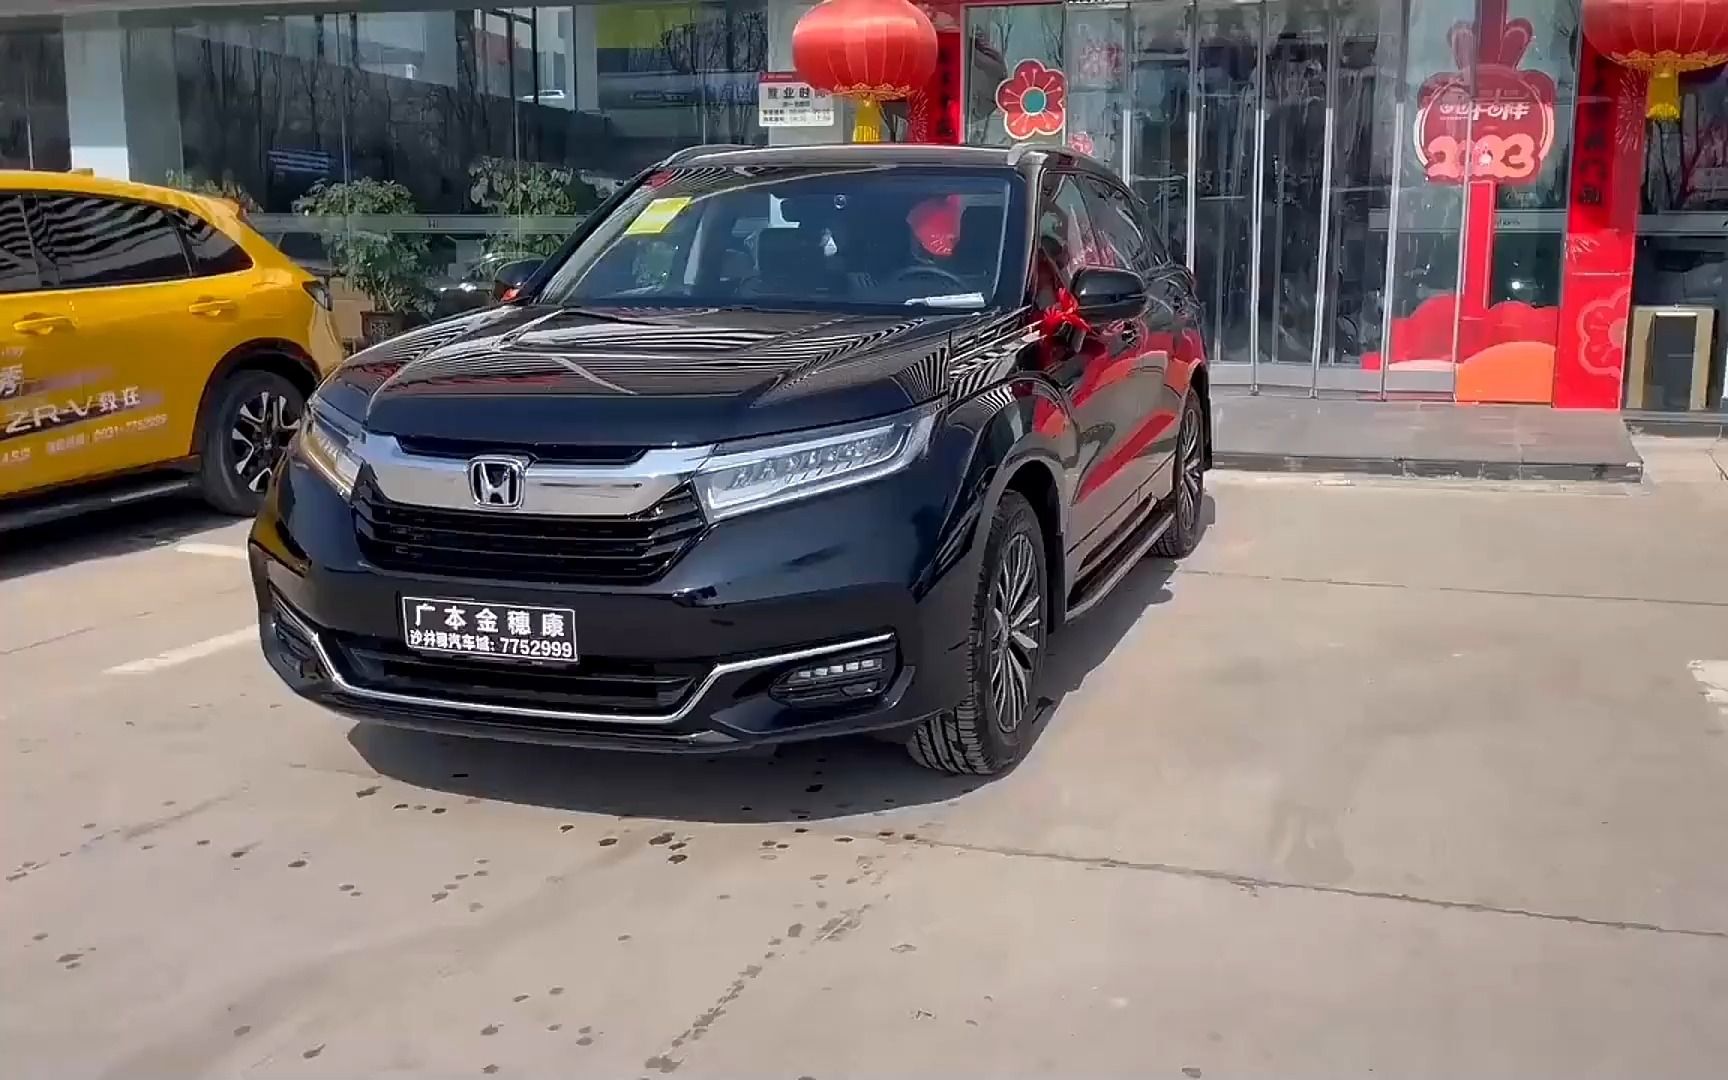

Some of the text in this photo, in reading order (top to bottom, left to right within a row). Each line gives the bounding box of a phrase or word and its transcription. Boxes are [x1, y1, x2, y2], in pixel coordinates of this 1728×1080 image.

[6, 395, 93, 433] ZR-V
[415, 603, 564, 637] 广本金穗康
[500, 637, 573, 658] 7752999
